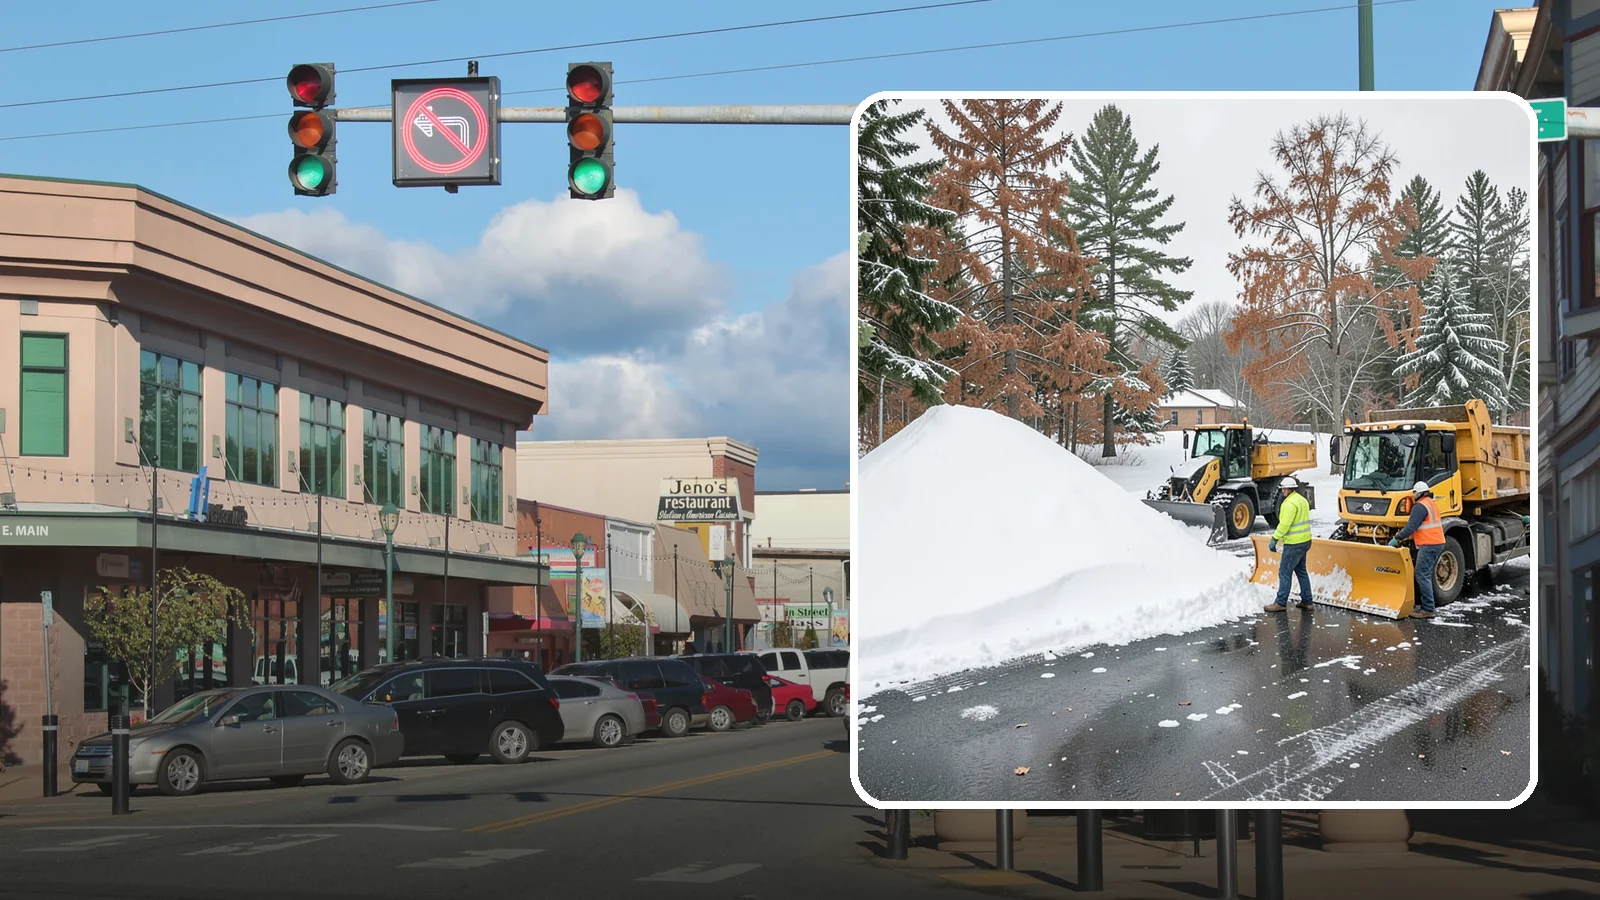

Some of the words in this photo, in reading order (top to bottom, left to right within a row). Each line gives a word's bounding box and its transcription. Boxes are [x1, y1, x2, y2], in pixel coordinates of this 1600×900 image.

[670, 480, 727, 494] Jeno's
[665, 497, 730, 509] restaurant
[658, 510, 681, 519] Italian
[686, 510, 714, 519] American
[714, 510, 737, 519] Cuisine
[2, 525, 13, 536] E.
[16, 525, 49, 536] MAIN
[786, 607, 795, 617] in
[798, 608, 828, 617] Street
[790, 619, 823, 627] lass
